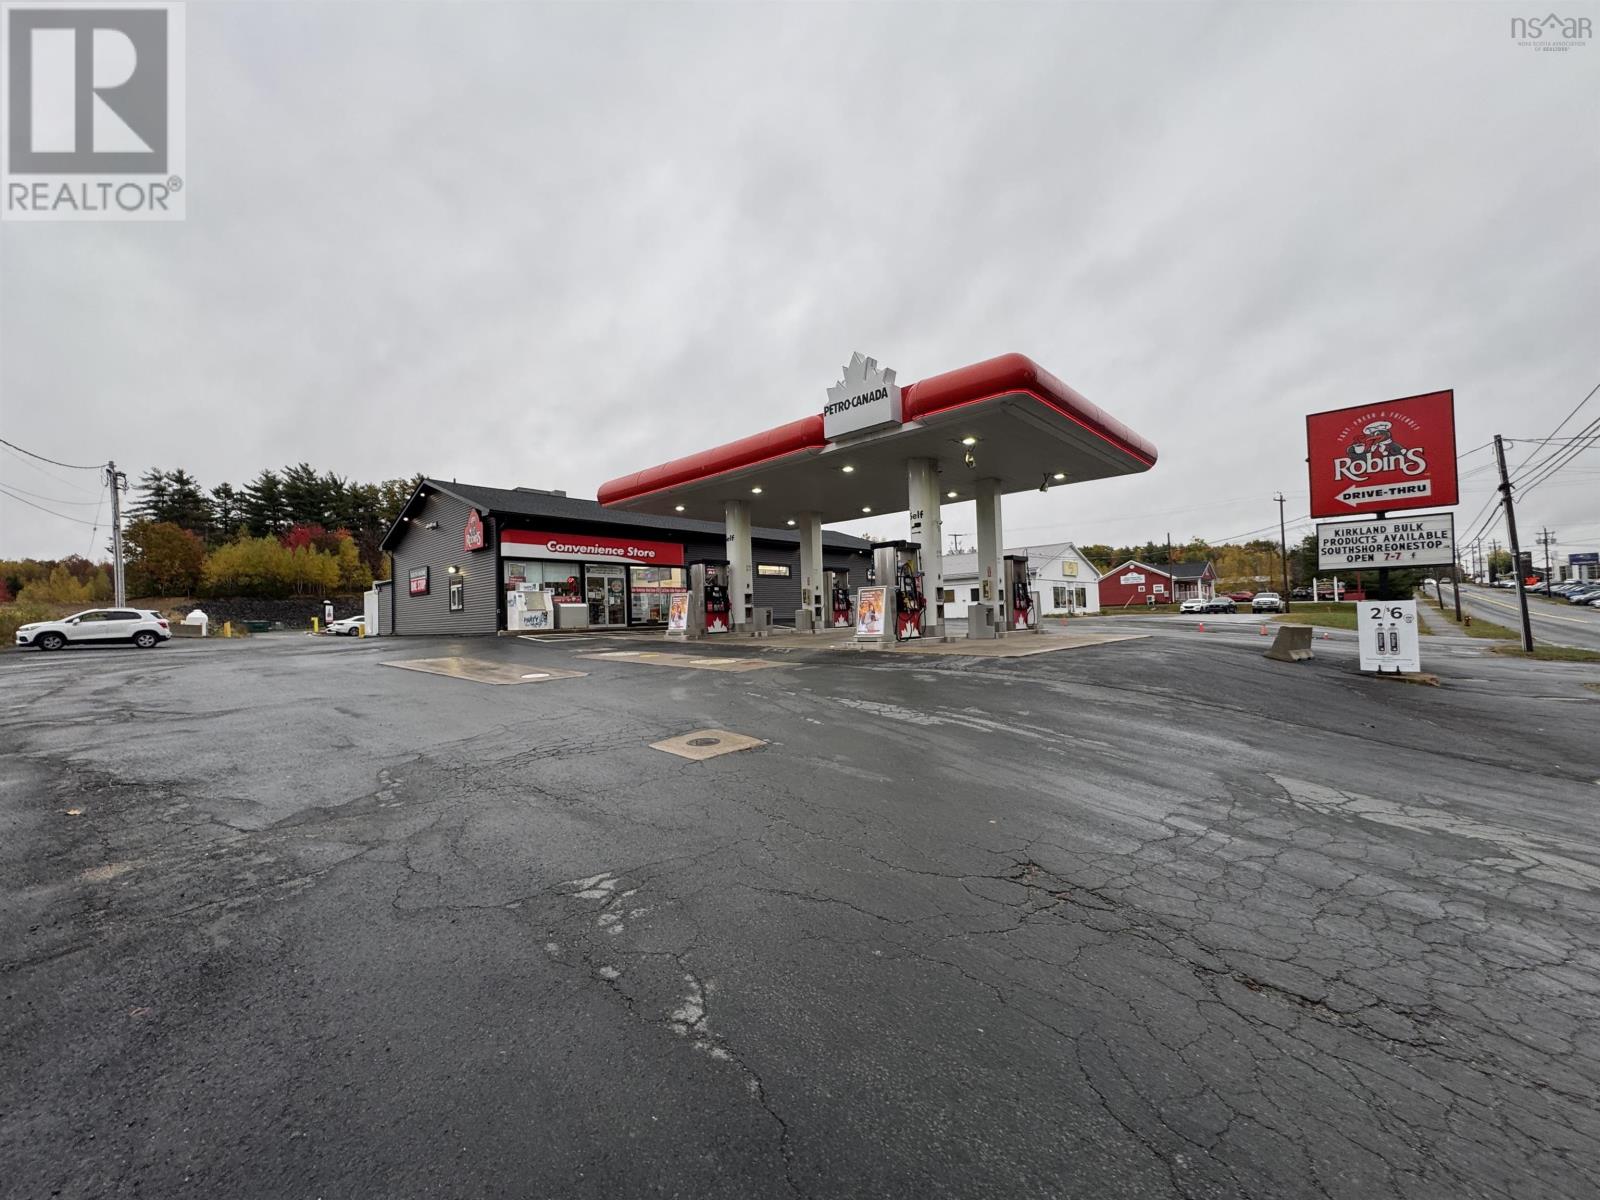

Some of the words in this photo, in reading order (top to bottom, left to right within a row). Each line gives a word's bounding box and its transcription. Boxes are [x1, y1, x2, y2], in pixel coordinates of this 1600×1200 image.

[1343, 484, 1427, 500] DRIVE-THRU
[1334, 525, 1387, 537] KIRKLAND
[1394, 522, 1423, 533] BULK
[1323, 535, 1378, 546] PRODUCTS
[1384, 530, 1448, 543] AVAILABLE
[546, 540, 625, 556] Convenience
[627, 546, 656, 558] Store
[1321, 540, 1443, 556] SOUTHSHOREONESTOP
[1346, 553, 1375, 563] OPEN
[1383, 552, 1402, 561] 7-7
